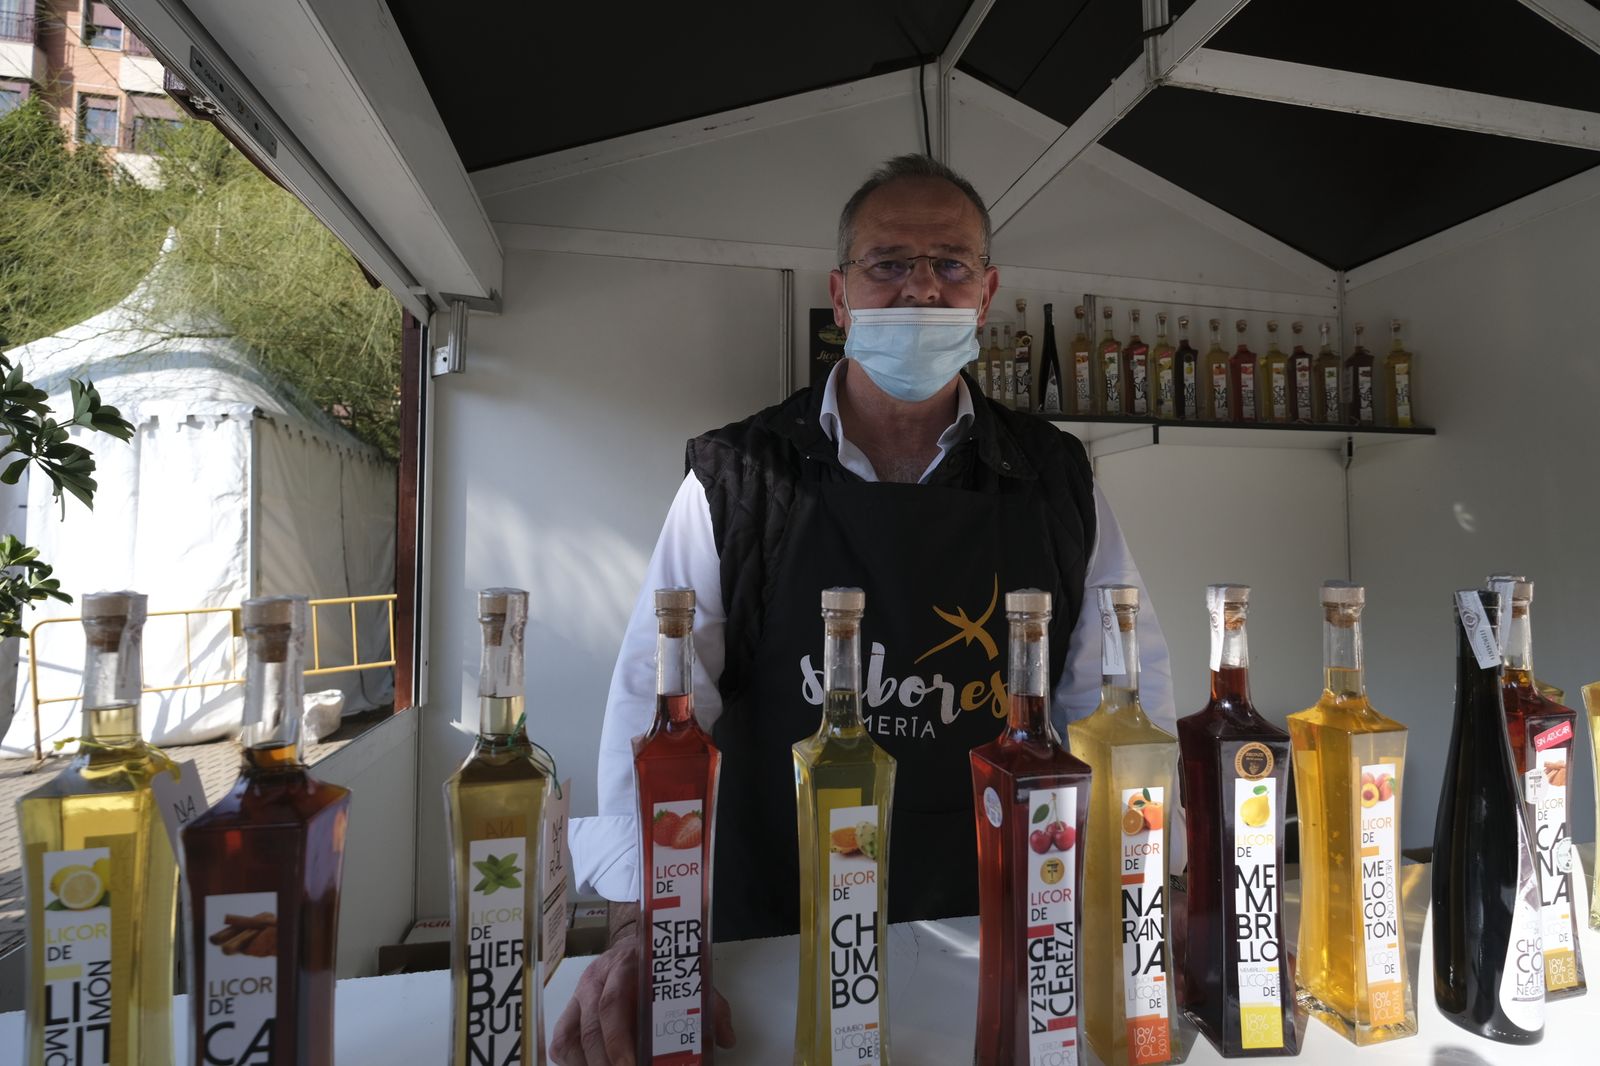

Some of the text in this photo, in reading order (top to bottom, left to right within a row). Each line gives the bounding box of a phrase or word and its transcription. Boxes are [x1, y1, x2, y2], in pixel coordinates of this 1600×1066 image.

[800, 641, 1009, 725] sbores
[1537, 798, 1564, 811] LICOR
[1362, 818, 1392, 831] LICOR
[1537, 811, 1549, 821] DE
[1237, 834, 1274, 846] LICOR
[1362, 832, 1375, 844] DE
[1536, 822, 1568, 851] CA
[1125, 844, 1160, 857] LICOR
[1237, 846, 1252, 858] DE
[656, 862, 699, 880] LICOR
[1125, 859, 1139, 871] DE
[1363, 860, 1385, 879] ME
[833, 871, 875, 888] LICOR
[1235, 864, 1275, 889] ME
[656, 880, 674, 894] DE
[833, 887, 850, 901] DE
[1363, 880, 1386, 901] LO
[1540, 875, 1570, 906] LA
[1031, 888, 1071, 906] LICOR
[1122, 886, 1164, 918] NA
[471, 907, 522, 925] LICOR
[1031, 907, 1047, 922] DE
[1364, 901, 1387, 920] CO
[47, 924, 108, 945] LICOR
[471, 925, 492, 941] DE
[674, 919, 702, 943] FR
[831, 911, 878, 949] CH
[1122, 917, 1165, 943] RAN
[1236, 912, 1278, 940] BRI
[1516, 937, 1543, 953] CHO
[1558, 933, 1569, 943] DE
[47, 945, 72, 961] DE
[468, 938, 524, 970] HIER
[652, 920, 672, 985] FRESA
[1028, 937, 1055, 963] CE
[1131, 940, 1166, 977] JA
[1238, 940, 1280, 963] LLO
[674, 956, 702, 979] SA
[831, 946, 878, 978] UM
[1048, 921, 1074, 1017] CEREZA
[1384, 963, 1396, 975] DE
[1516, 951, 1544, 974] CO
[1549, 958, 1567, 975] 18%
[209, 977, 273, 998] LICOR
[468, 966, 524, 1012] BA
[1239, 973, 1274, 988] LICOR
[652, 981, 703, 1002] FRESA
[831, 974, 878, 1010] BO
[1128, 984, 1161, 1001] LICOR
[1263, 986, 1276, 997] DE
[209, 997, 235, 1016] DE
[1149, 998, 1162, 1009] DE
[656, 1017, 696, 1037] LICOR
[1133, 1025, 1156, 1046] 18%
[204, 1018, 276, 1066] CA
[680, 1031, 696, 1045] DE
[834, 1031, 873, 1051] LICOR
[858, 1045, 873, 1059] DE
[1135, 1045, 1159, 1058] VOL
